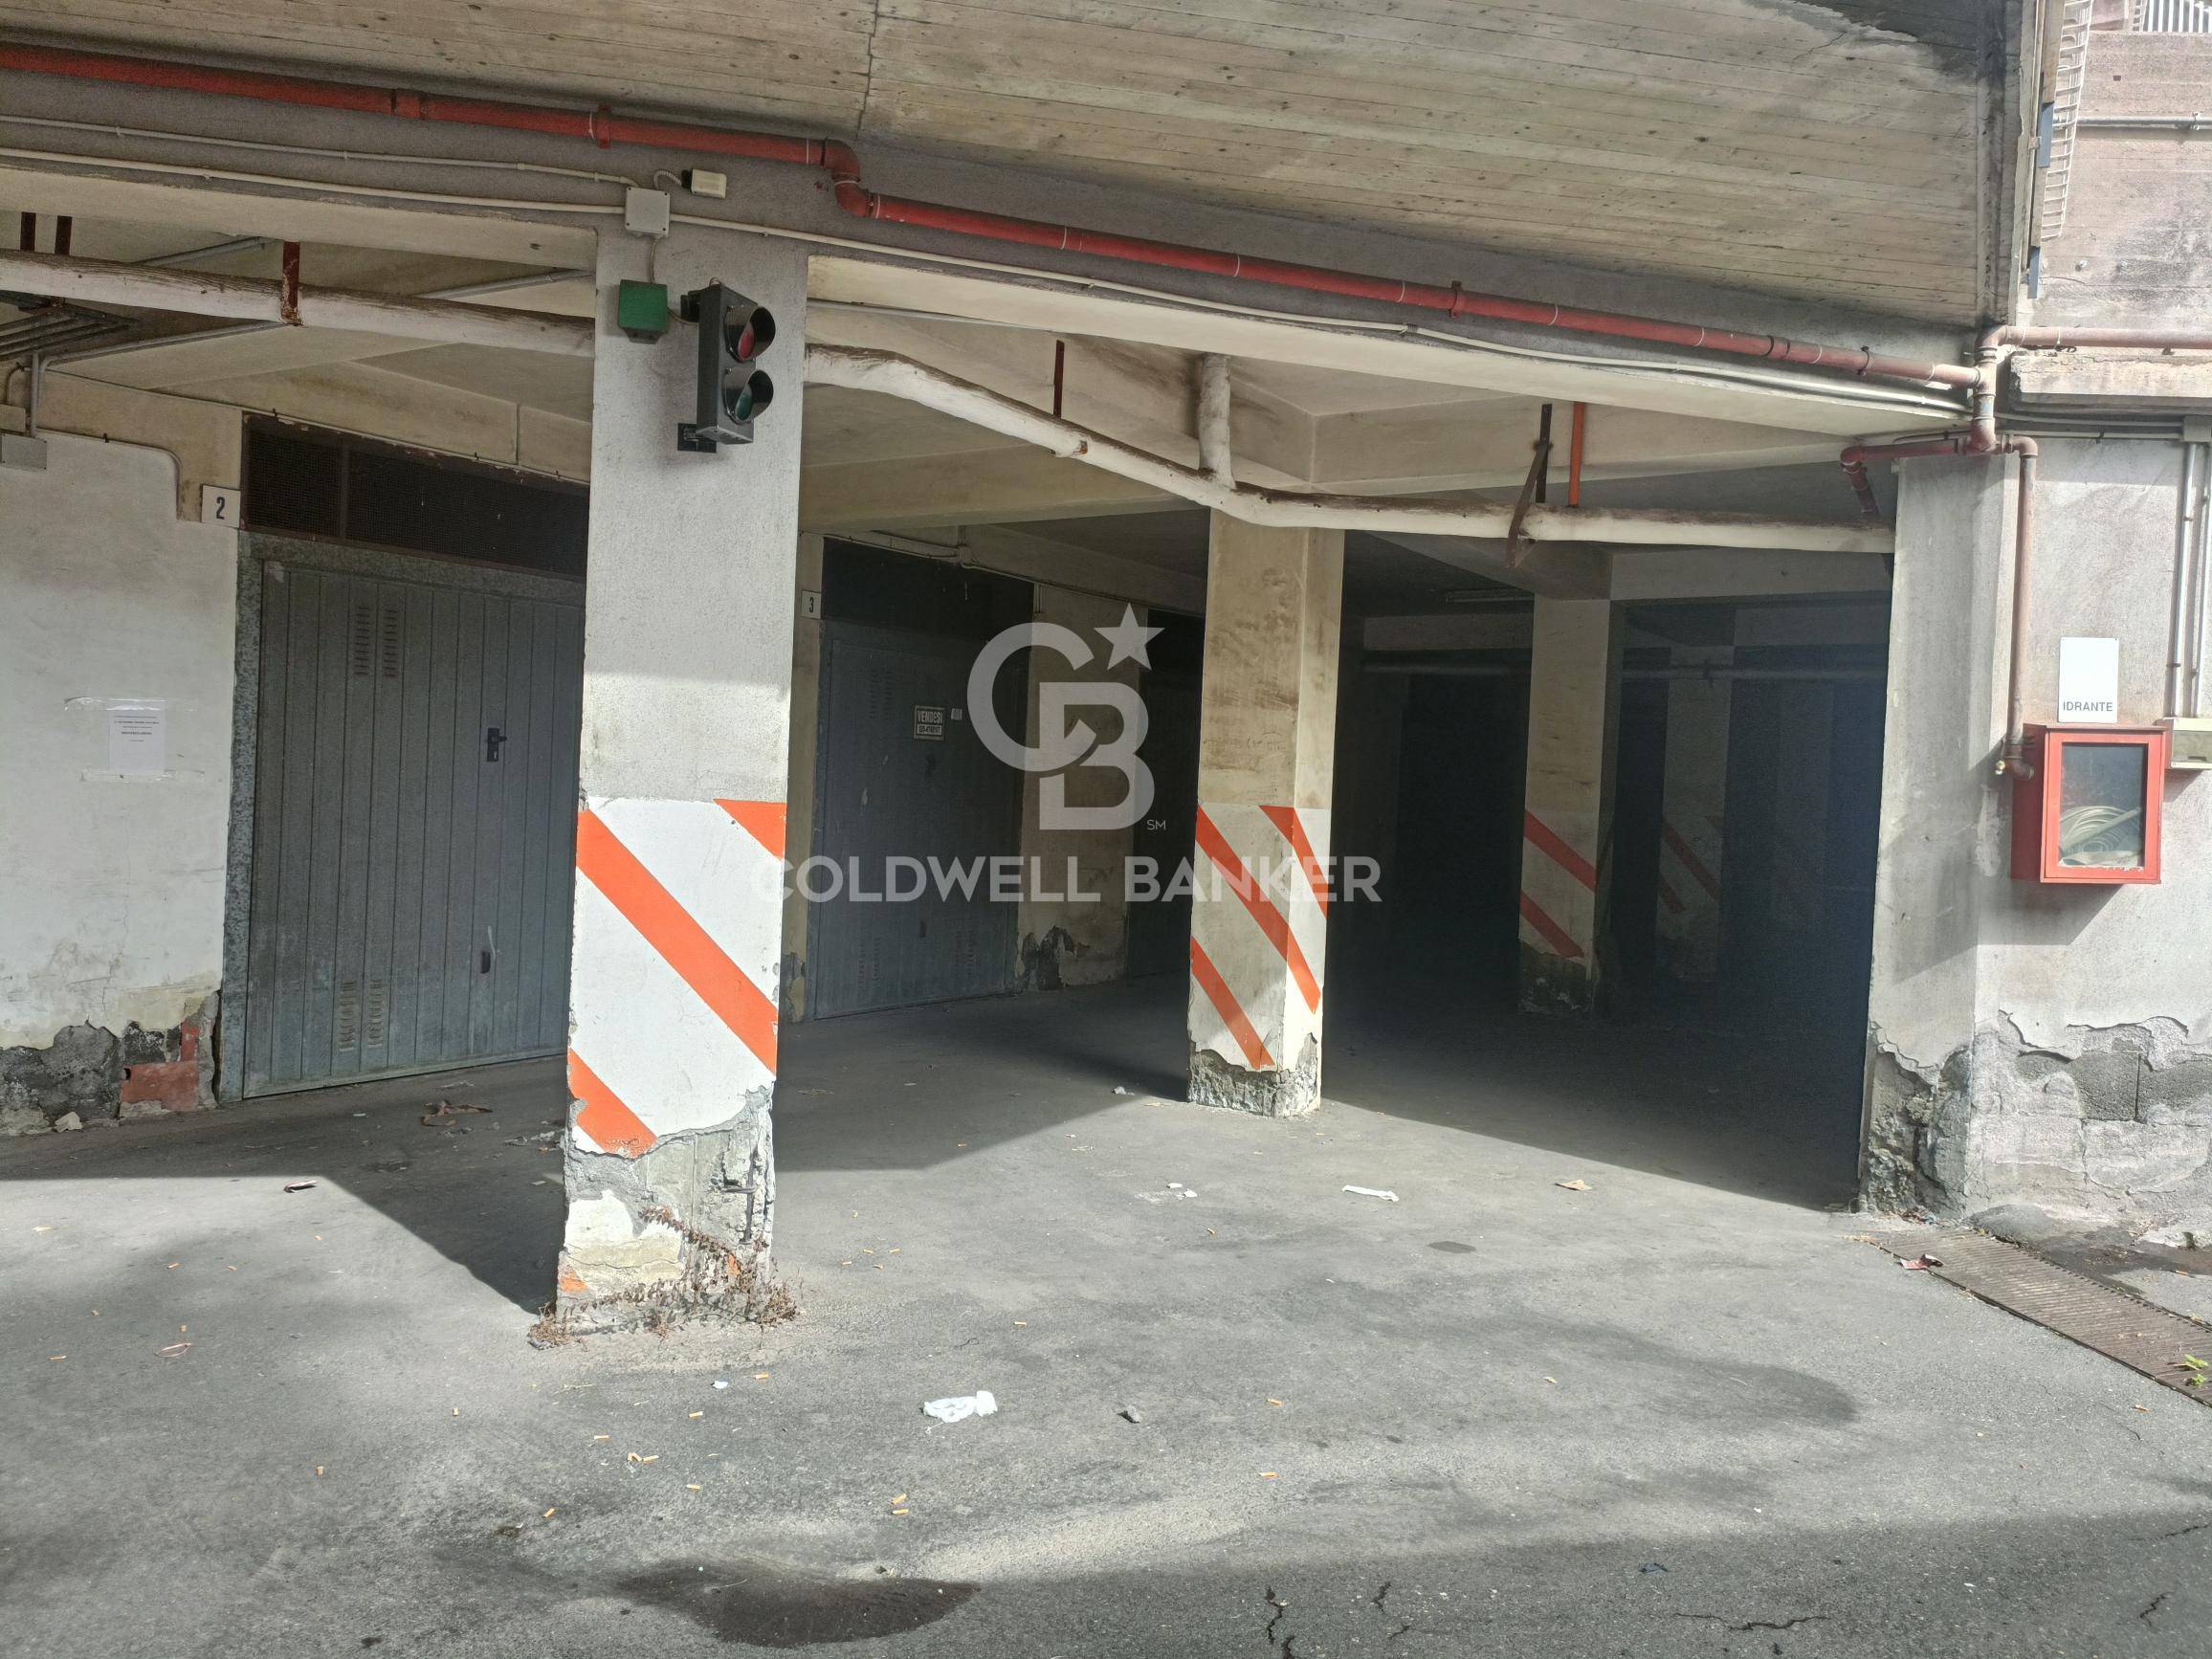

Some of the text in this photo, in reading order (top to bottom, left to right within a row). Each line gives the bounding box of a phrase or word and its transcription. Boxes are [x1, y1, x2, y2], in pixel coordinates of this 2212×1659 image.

[216, 497, 225, 520] 2
[808, 596, 814, 613] 3
[2063, 700, 2113, 712] IDRANTE
[918, 710, 942, 723] VENDESI
